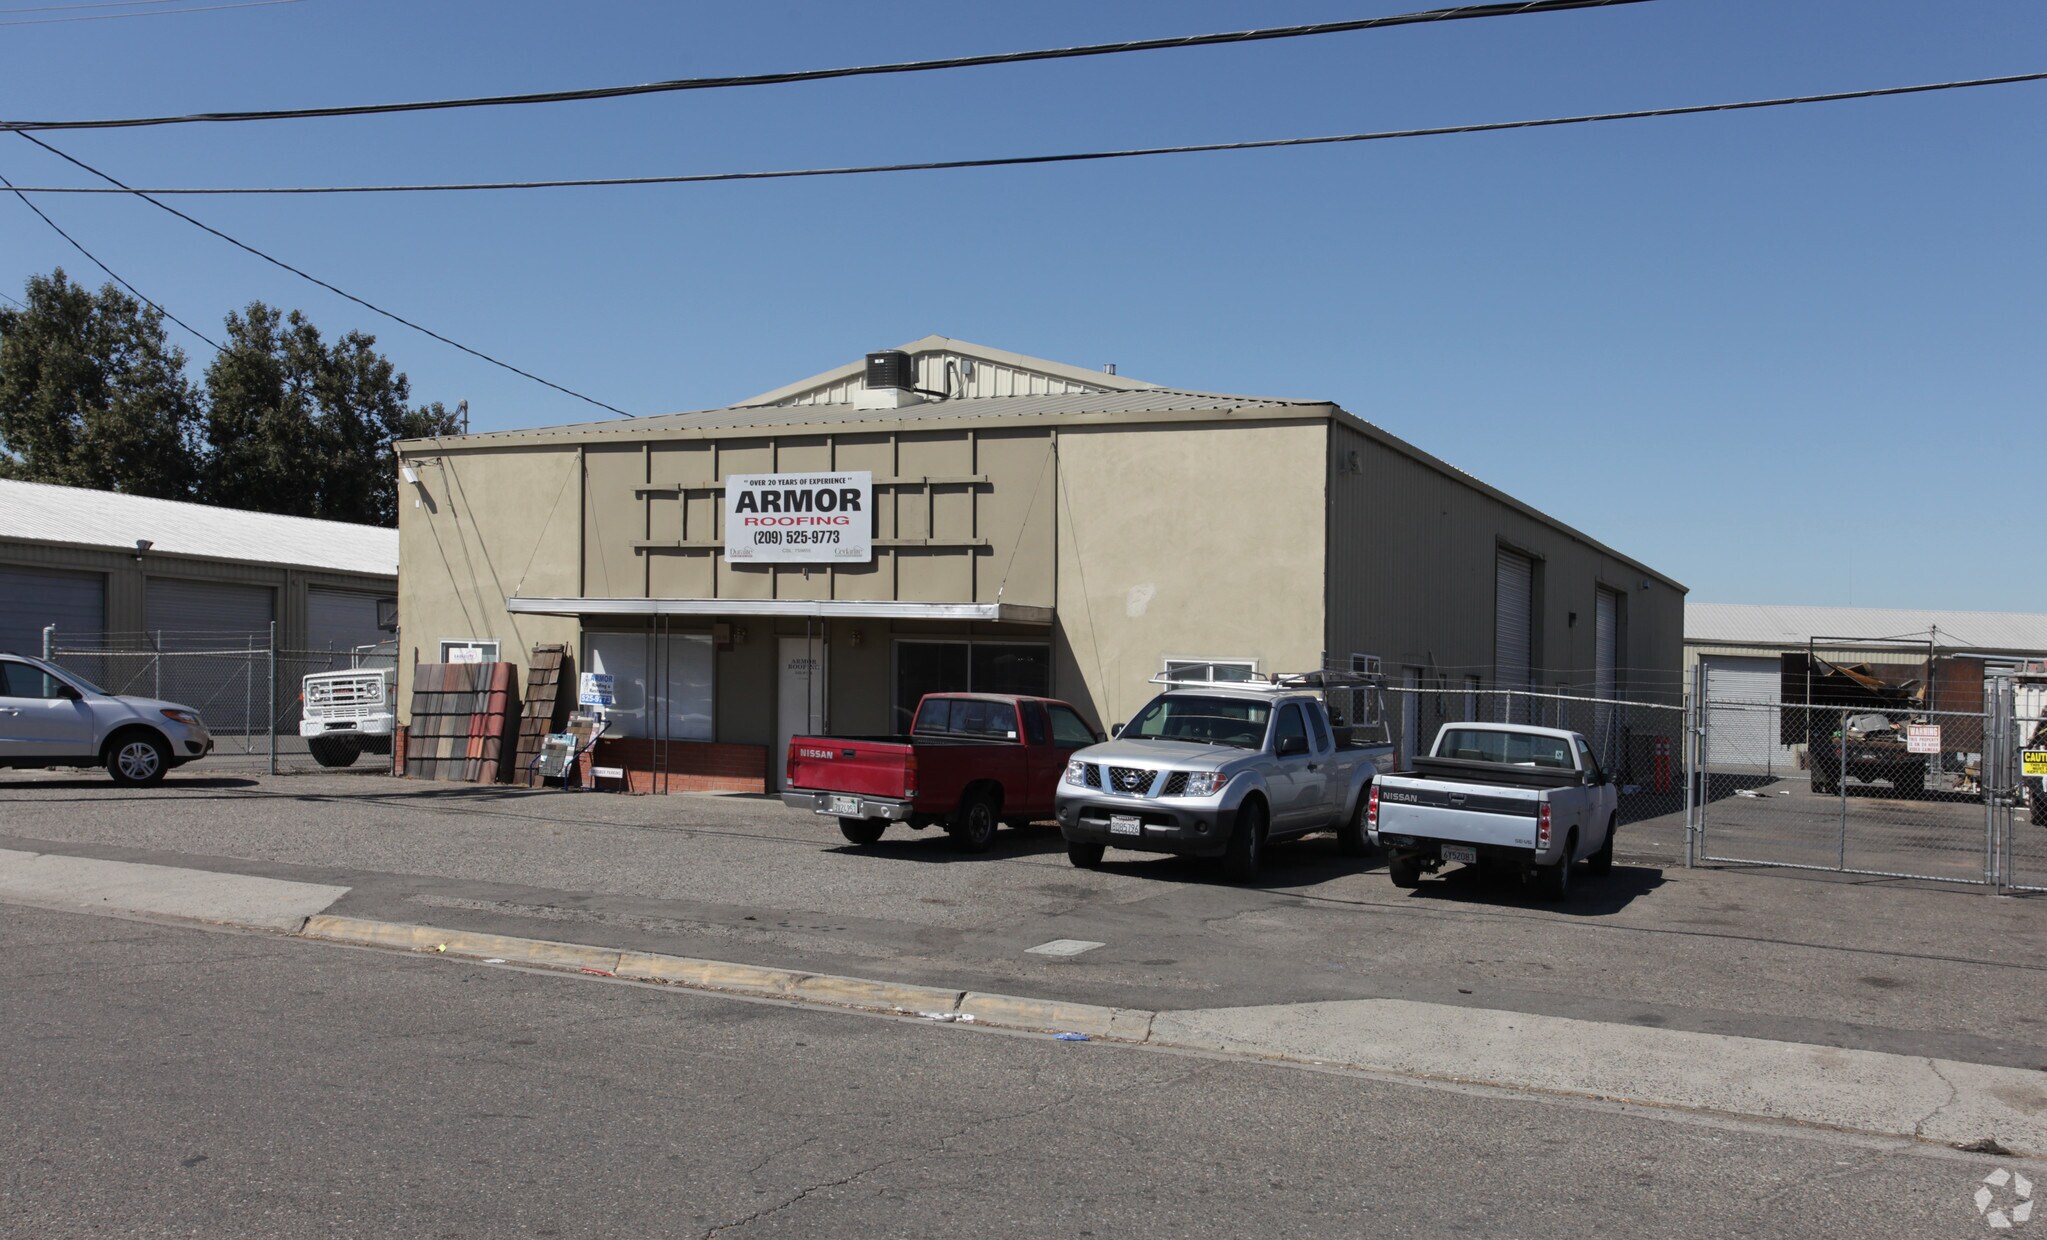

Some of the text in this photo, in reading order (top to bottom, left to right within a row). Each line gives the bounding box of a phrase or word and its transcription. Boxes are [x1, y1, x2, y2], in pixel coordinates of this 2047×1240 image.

[736, 489, 861, 514] ARMOR
[745, 516, 849, 526] ROOFING
[754, 530, 840, 545] (209) 525-9773
[591, 675, 613, 683] ARMOR
[1910, 727, 1938, 736] WARNING
[800, 749, 834, 759] NISSAN
[1383, 792, 1418, 803] NISSAN
